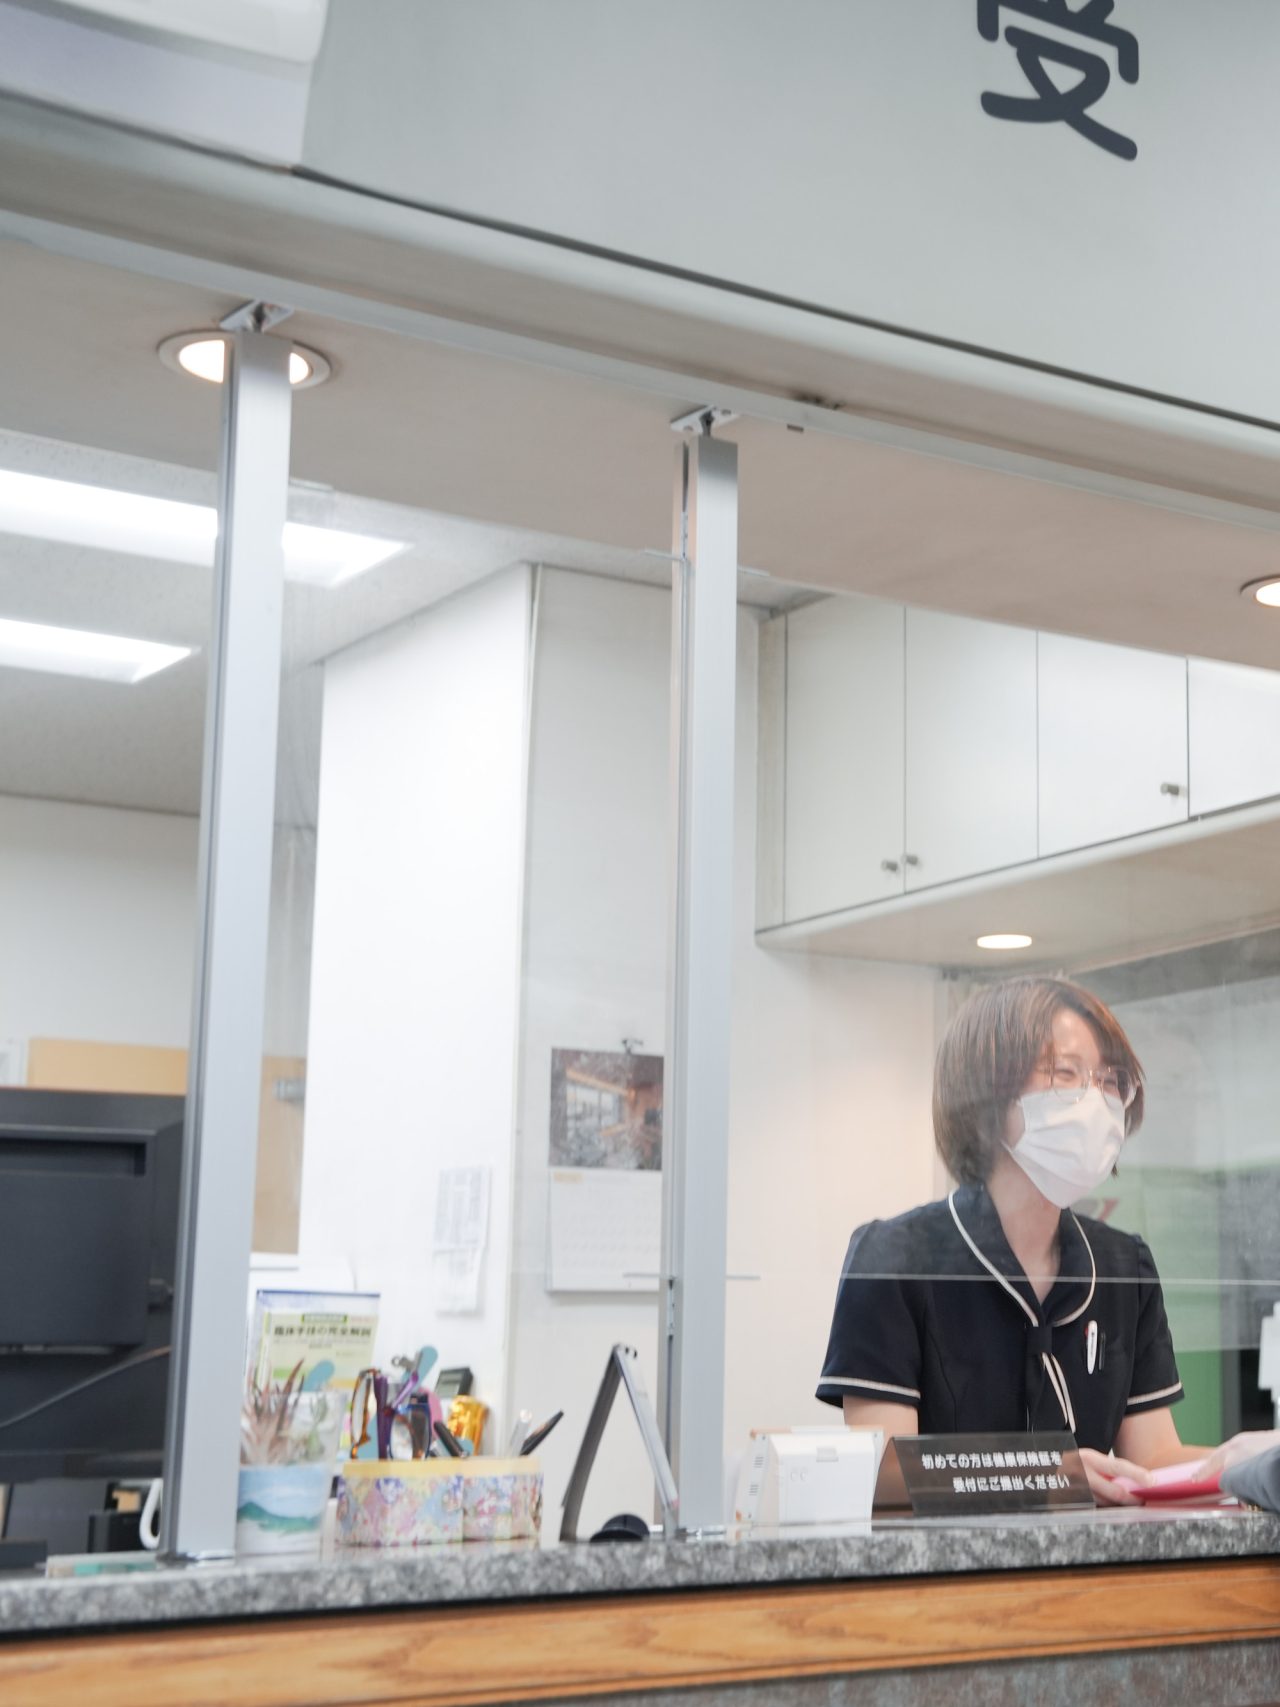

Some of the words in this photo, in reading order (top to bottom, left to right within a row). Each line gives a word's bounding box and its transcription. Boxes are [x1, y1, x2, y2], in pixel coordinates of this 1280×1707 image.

[921, 1451, 1062, 1470] 初めての方は健康保険証を
[953, 1474, 1070, 1493] 受付にご提出ください
